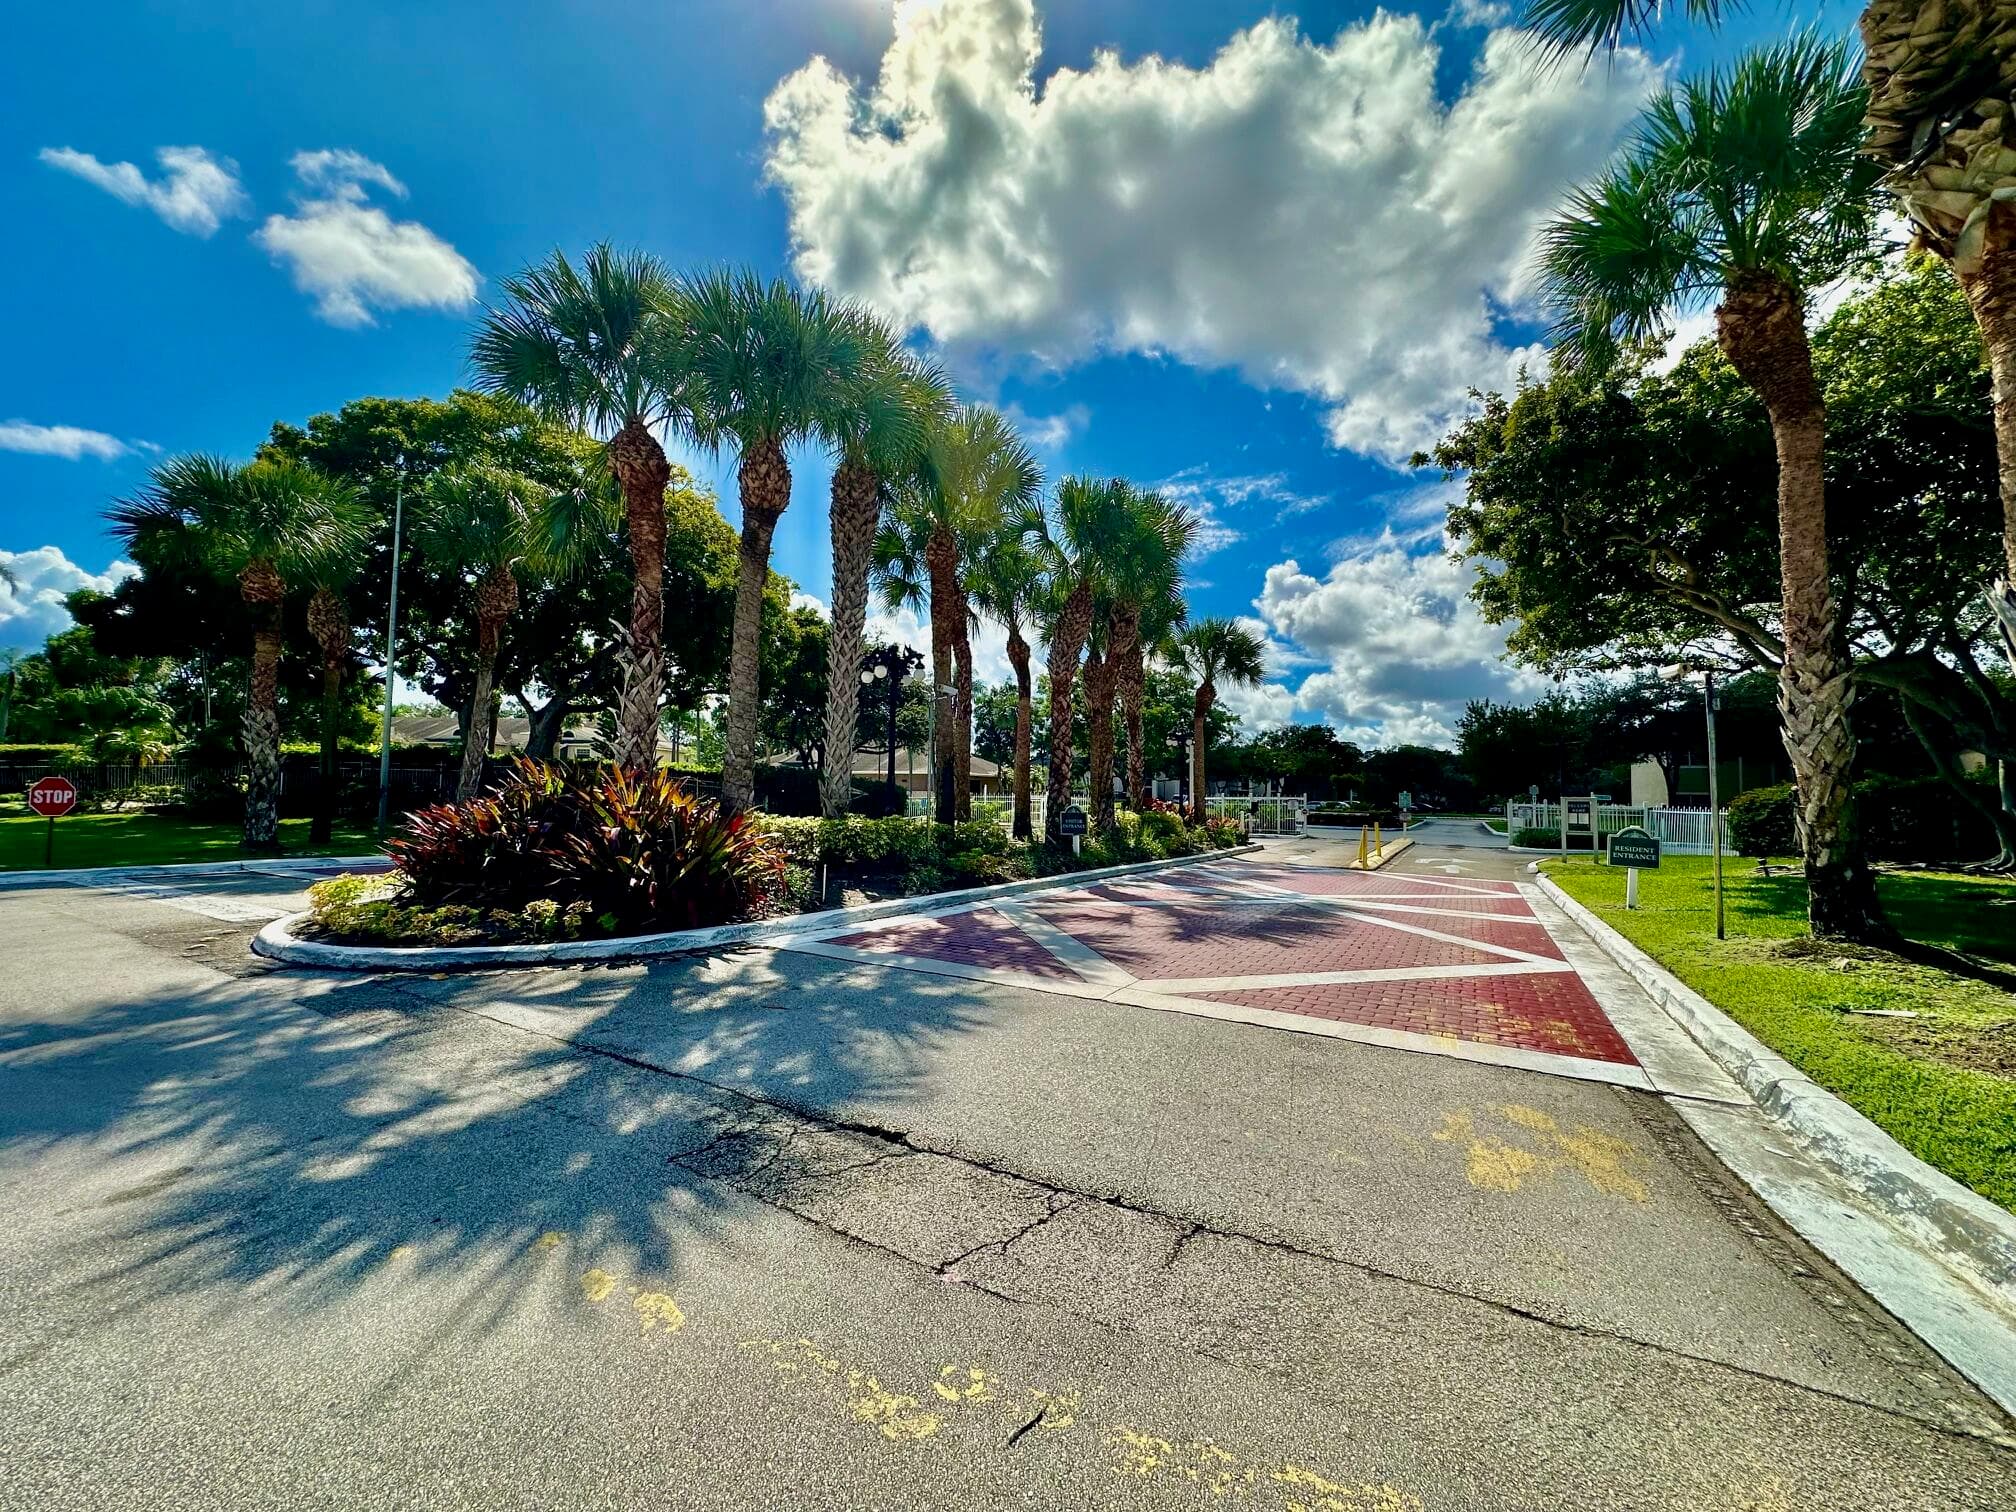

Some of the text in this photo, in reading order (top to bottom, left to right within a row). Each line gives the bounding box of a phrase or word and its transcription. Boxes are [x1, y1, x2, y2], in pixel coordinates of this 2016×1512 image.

[33, 789, 73, 803] STOP
[1614, 845, 1655, 854] RESIDENT
[1613, 852, 1656, 861] ENTRANCE
